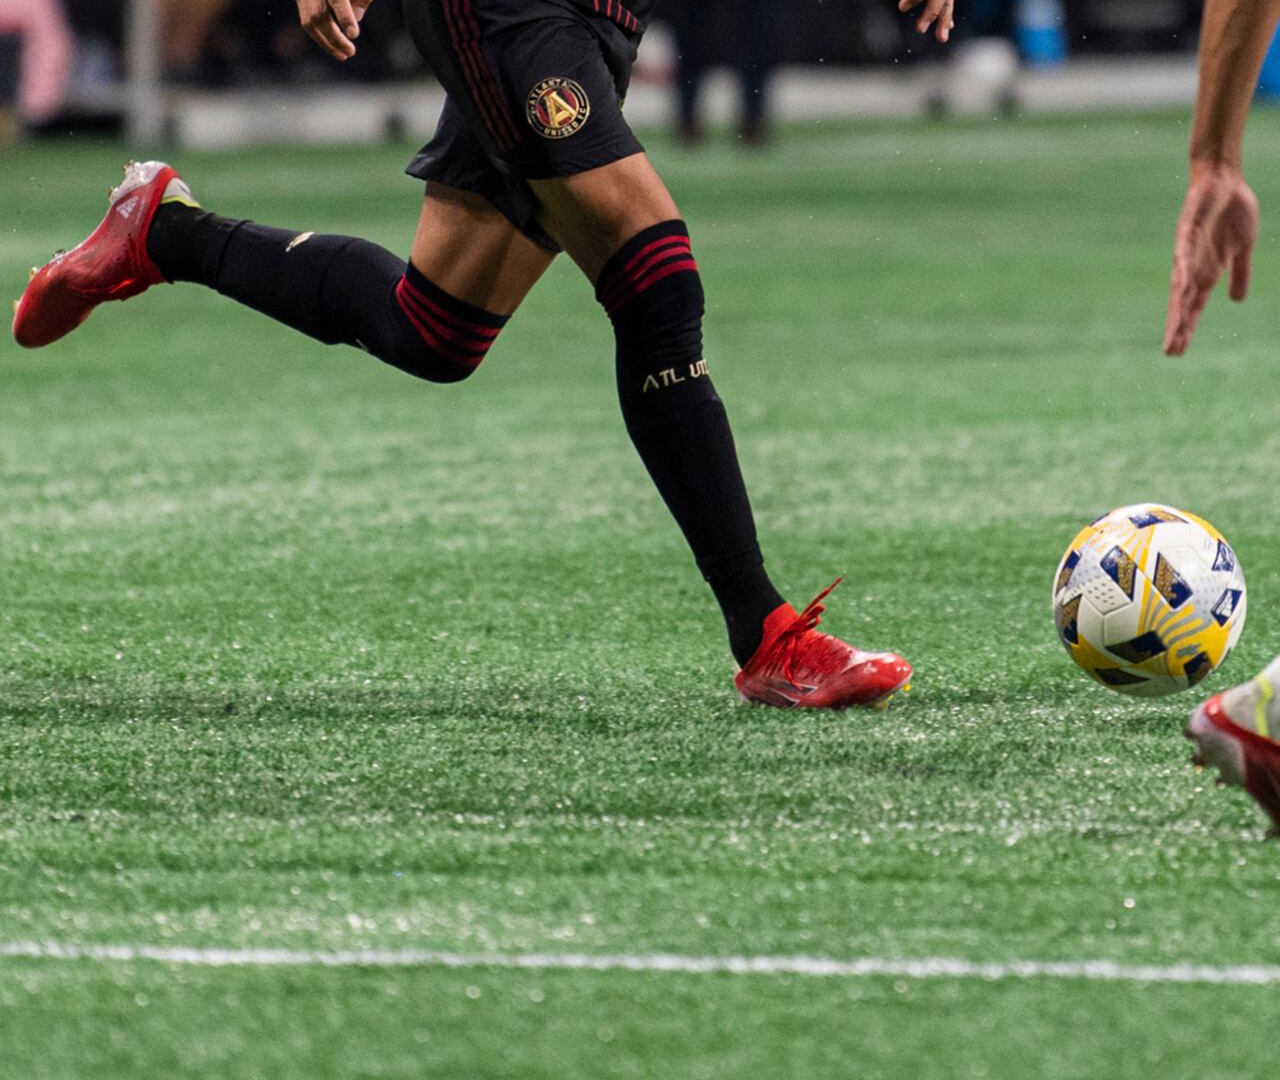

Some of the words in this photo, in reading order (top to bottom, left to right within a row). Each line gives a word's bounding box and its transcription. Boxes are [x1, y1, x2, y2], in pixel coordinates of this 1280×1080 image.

[529, 79, 568, 105] ATLANTA
[543, 121, 579, 137] UNITED
[642, 367, 686, 393] ATL
